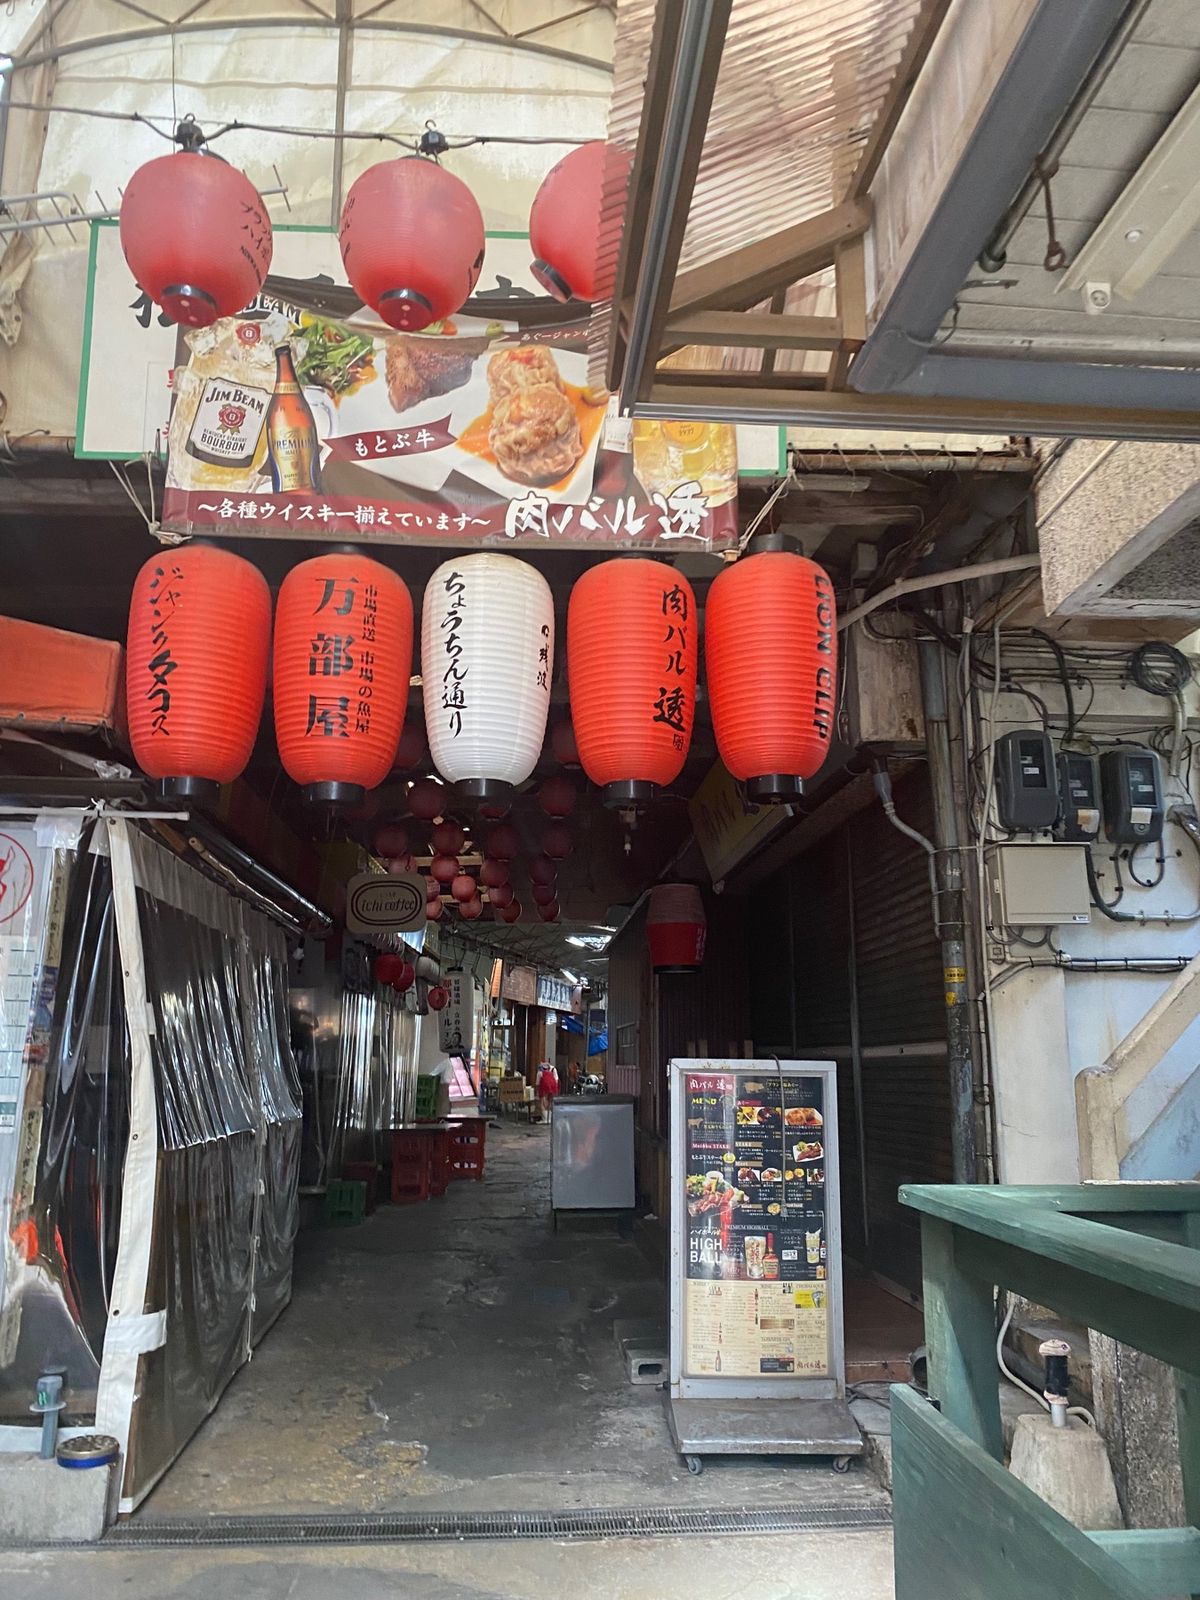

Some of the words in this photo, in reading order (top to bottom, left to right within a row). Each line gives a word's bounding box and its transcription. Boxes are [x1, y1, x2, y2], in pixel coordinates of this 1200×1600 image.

[205, 387, 231, 403] JIM
[232, 389, 265, 415] BEAM
[201, 433, 246, 452] BOURBON
[355, 429, 436, 457] もとぶ牛
[362, 584, 378, 642] 市場直送
[815, 574, 832, 655] LION
[145, 567, 185, 737] ジャンクタコス
[304, 576, 360, 738] 万部屋
[440, 571, 470, 739] ちょうちん通り
[355, 650, 375, 735] 市場の魚屋
[813, 667, 832, 740] CLIP
[690, 1237, 723, 1250] HIGH
[690, 1251, 723, 1264] BALL
